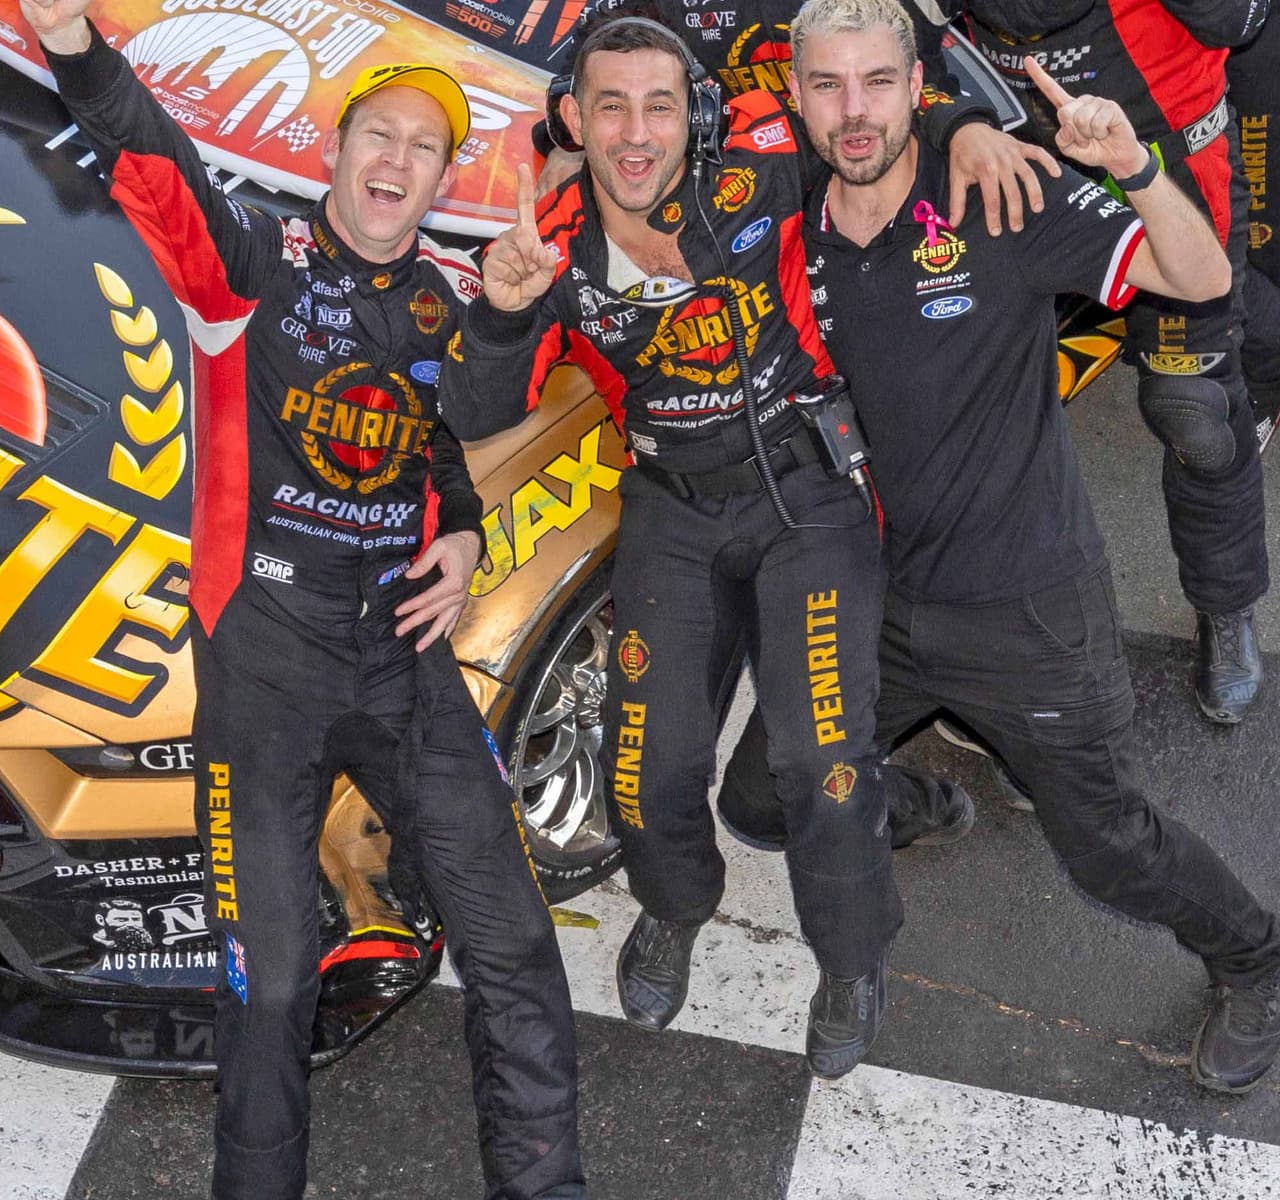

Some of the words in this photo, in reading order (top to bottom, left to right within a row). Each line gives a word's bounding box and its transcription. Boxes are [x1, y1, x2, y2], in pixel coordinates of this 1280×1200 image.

[456, 8, 492, 33] 500
[685, 10, 736, 29] GROVE
[701, 28, 722, 41] HIRE
[307, 15, 387, 82] 500
[752, 126, 787, 148] OMP
[736, 220, 767, 250] Ford
[911, 240, 968, 263] PENRITE
[915, 275, 954, 289] RACING
[318, 308, 354, 326] NED
[926, 298, 967, 317] Ford
[580, 309, 639, 337] GROVE
[634, 280, 776, 368] PENRITE
[281, 316, 352, 357] GROVE
[601, 330, 627, 346] HIRE
[298, 343, 328, 365] HIRE
[646, 389, 745, 413] RACING
[279, 386, 434, 455] PENRITE
[272, 484, 384, 526] RACING
[466, 419, 623, 599] JAX
[266, 515, 332, 539] AUSTRALIAN
[332, 531, 374, 550] OWNED
[253, 557, 295, 580] OMP
[627, 629, 639, 684] PENRITE
[805, 588, 848, 747] PENRITE
[613, 700, 647, 830] PENRITE
[208, 762, 241, 922] PENRITE
[54, 856, 164, 878] DASHER
[101, 951, 218, 971] AUSTRALIAN
